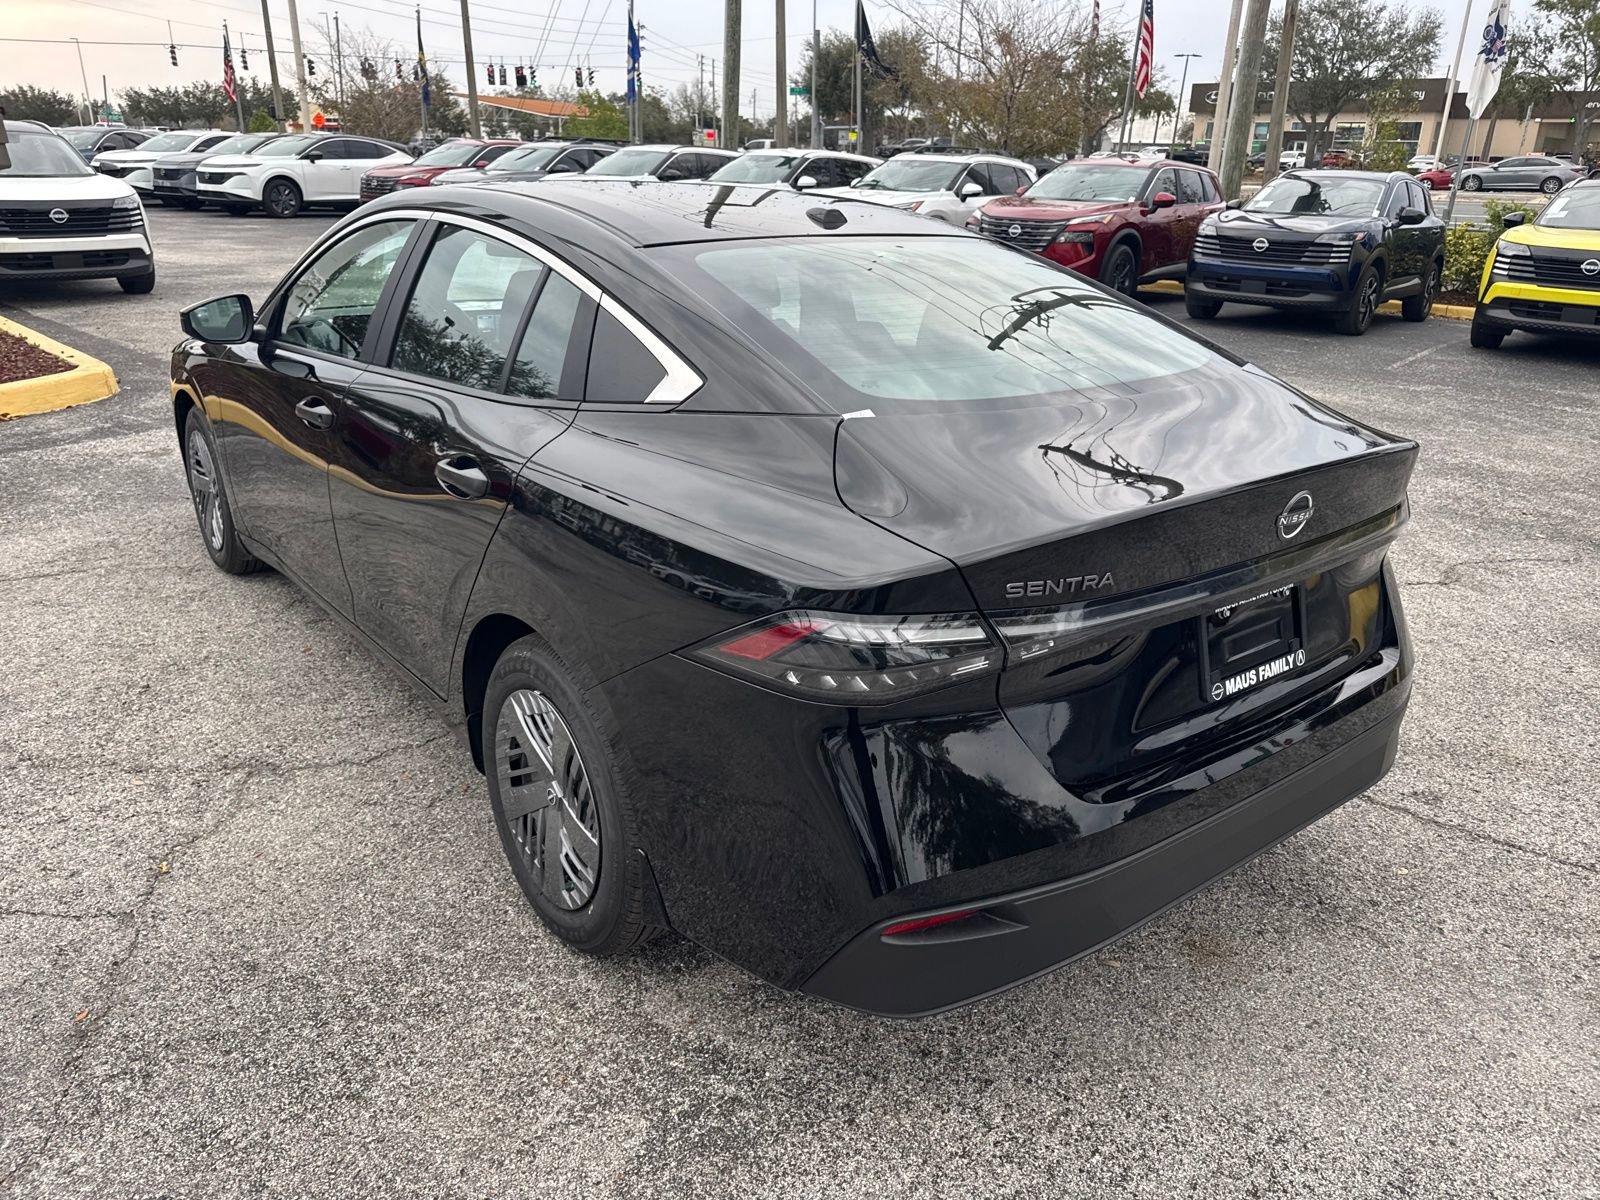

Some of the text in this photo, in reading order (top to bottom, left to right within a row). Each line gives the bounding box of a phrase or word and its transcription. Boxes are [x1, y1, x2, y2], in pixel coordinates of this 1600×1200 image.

[1005, 572, 1114, 598] SENTRA
[1225, 653, 1295, 695] MAUS FAMILY
